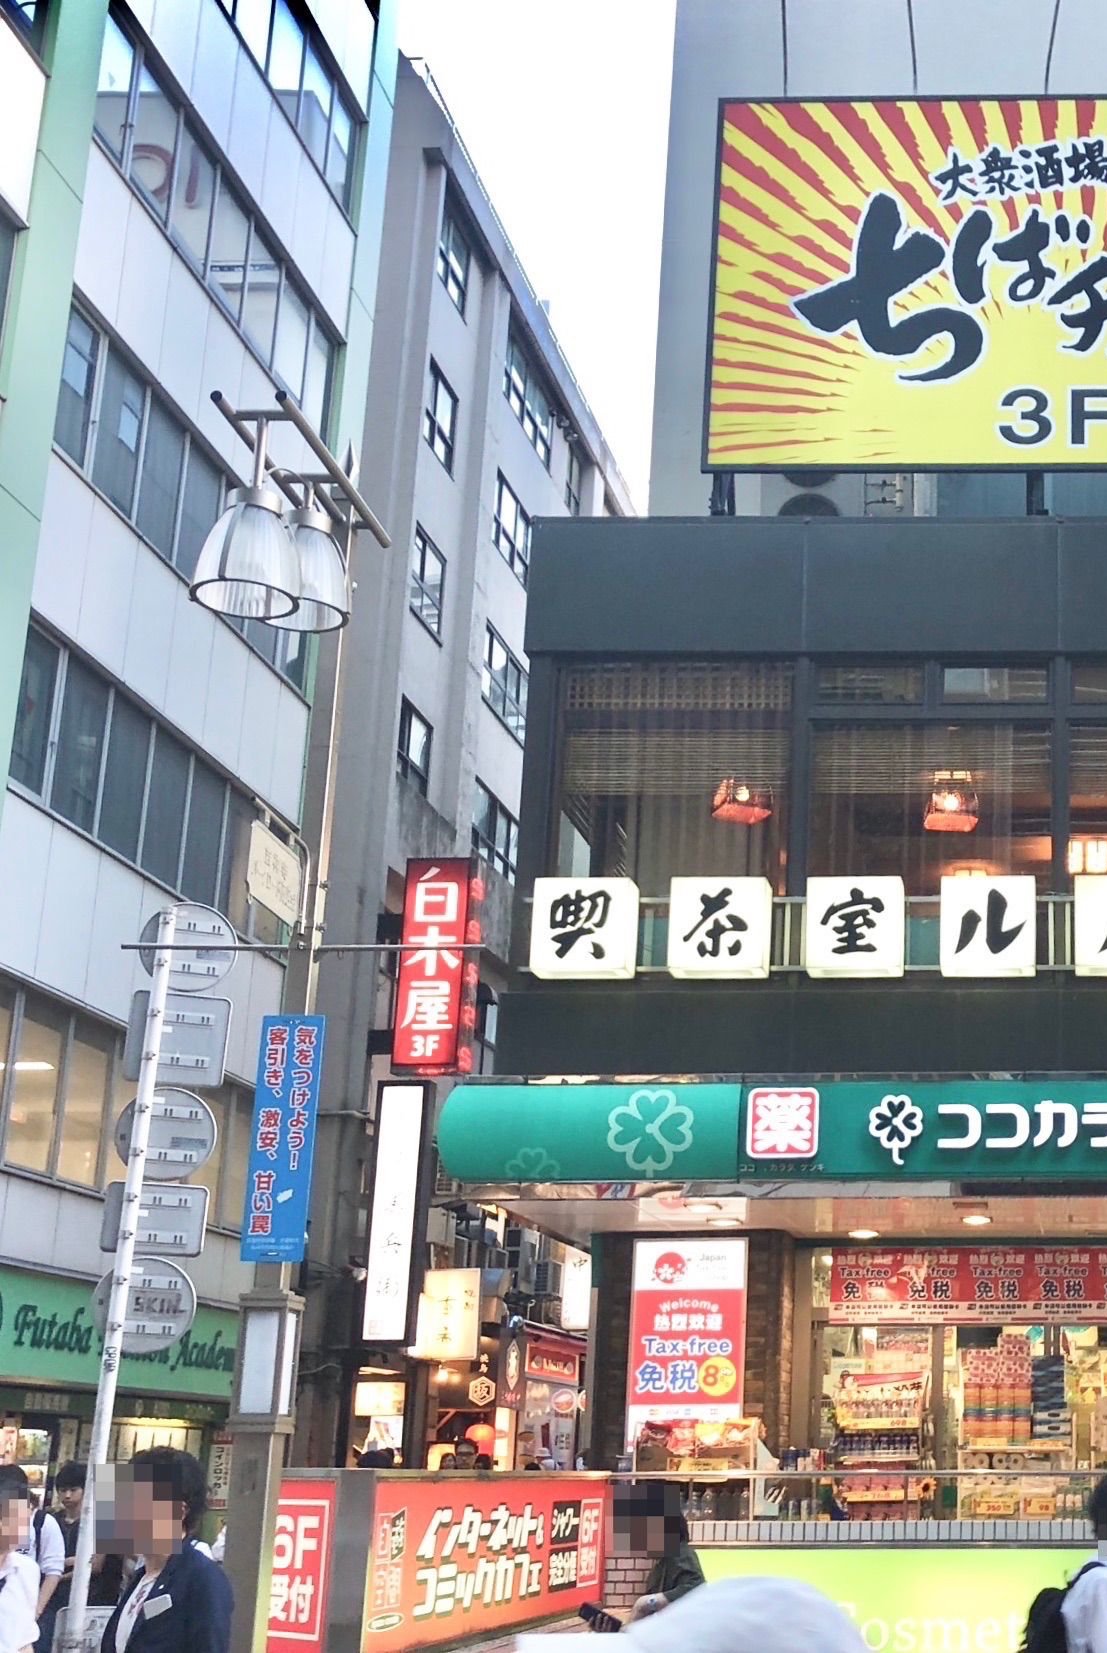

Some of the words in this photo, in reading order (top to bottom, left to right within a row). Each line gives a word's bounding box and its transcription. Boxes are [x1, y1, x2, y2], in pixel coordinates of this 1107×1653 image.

[400, 866, 460, 1030] 白木屋
[410, 1034, 440, 1057] 3F
[753, 1092, 813, 1153] 薬
[699, 1253, 727, 1263] Japan
[659, 1297, 720, 1314] Welcome
[908, 1279, 952, 1301] 免税
[974, 1279, 1019, 1301] 免税
[1040, 1279, 1085, 1300] 免税
[13, 1303, 94, 1354] Futaba
[170, 1329, 237, 1374] Academ
[642, 1336, 733, 1357] Tax-free
[636, 1360, 699, 1394] 免税
[416, 1504, 545, 1558] インターネット&
[551, 1507, 580, 1538] シャワー
[581, 1508, 600, 1543] 6F
[273, 1514, 320, 1570] 6F
[268, 1573, 315, 1624] 受付
[412, 1554, 543, 1618] コミックカフェ
